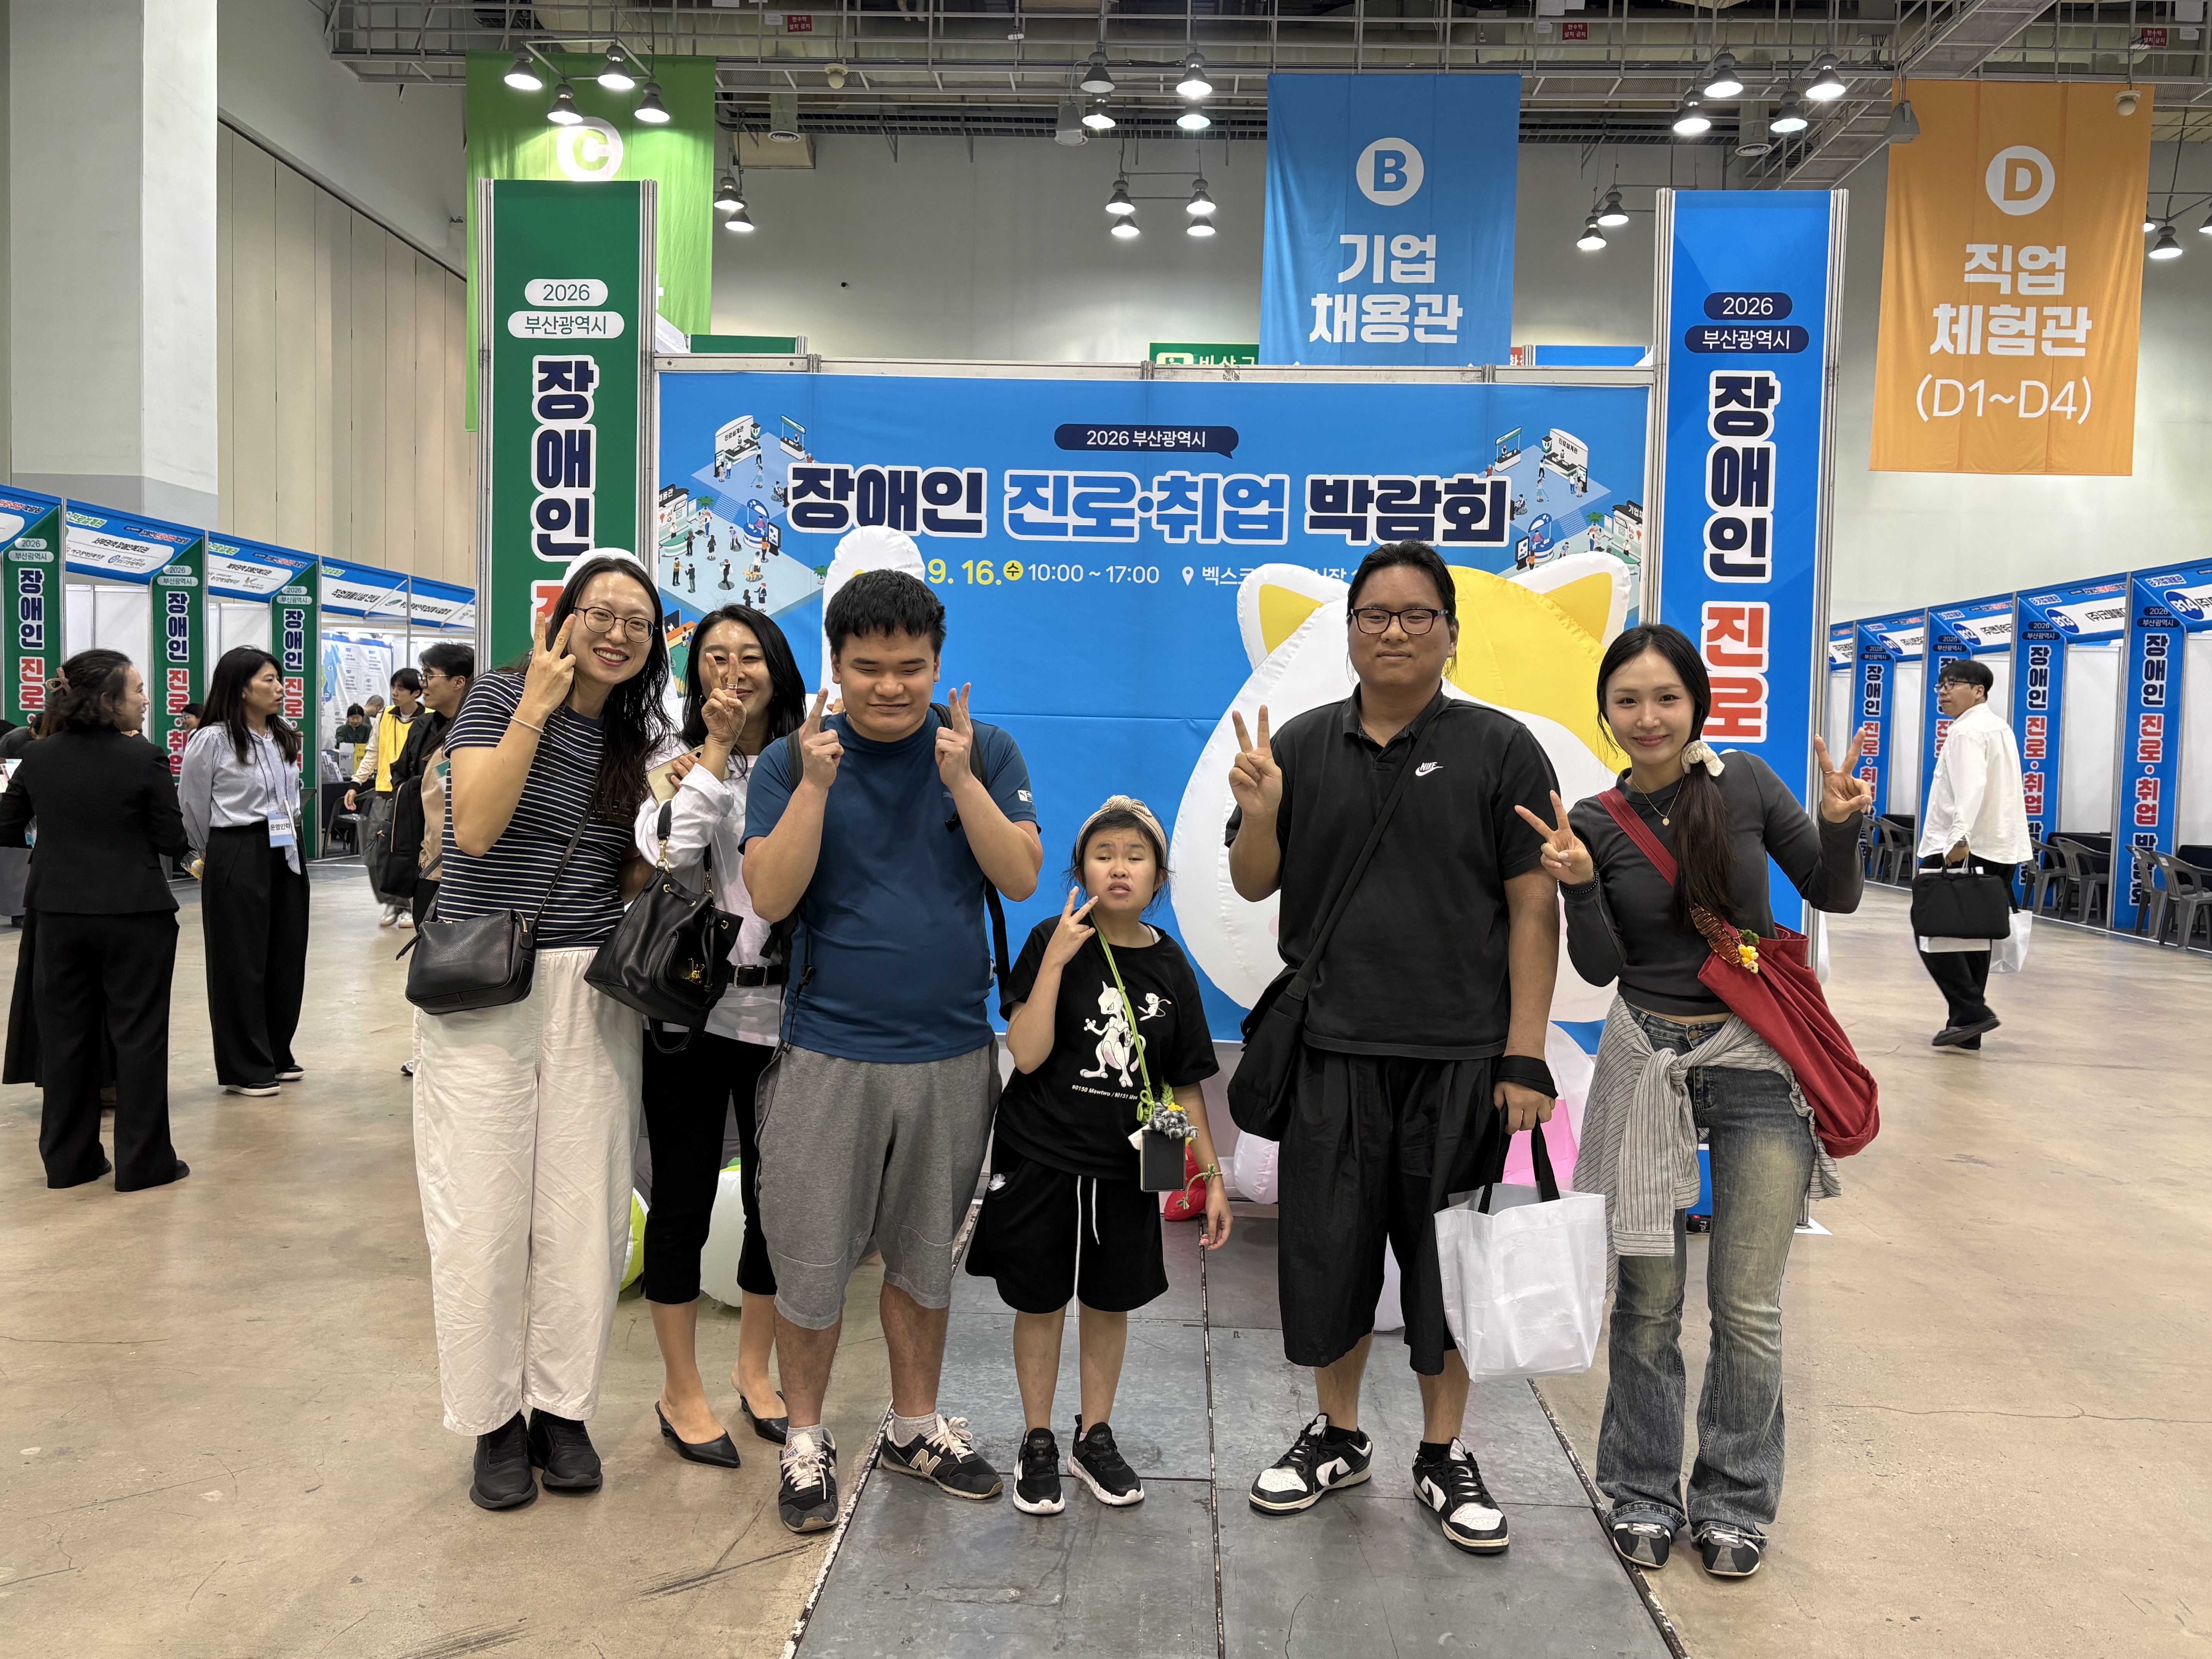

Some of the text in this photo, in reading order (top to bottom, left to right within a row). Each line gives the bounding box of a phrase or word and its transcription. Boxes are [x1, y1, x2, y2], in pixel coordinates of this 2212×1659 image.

[1373, 149, 1408, 191] B
[2003, 158, 2043, 201] D
[1338, 234, 1436, 283] 기업
[1964, 244, 2066, 295] 직업
[543, 284, 590, 301] 2026
[1722, 297, 1774, 315] 2026
[524, 315, 606, 335] 부산광역시
[1309, 293, 1463, 343] 채용관
[1702, 329, 1790, 350] 부산광역시
[1930, 303, 2092, 357] 체험관
[1916, 373, 2092, 425] (D1~D4)
[534, 359, 596, 558] 장애인
[1086, 430, 1206, 448] 2026 부산광역시
[1708, 375, 1776, 578] 장애인
[790, 466, 984, 534] 장애인
[1307, 476, 1508, 543] 박람회
[15, 552, 47, 561] 부산광역시
[1028, 563, 1084, 582] 10:00
[1106, 565, 1160, 584] 17:00
[19, 570, 43, 648] 장애인
[167, 592, 189, 661] 장애인
[2051, 615, 2075, 627] B13
[2170, 599, 2200, 613] B14
[285, 610, 305, 670] 장애인
[1864, 665, 1883, 716] 장애인
[2028, 646, 2050, 709] 장애인
[2143, 634, 2169, 706] 장애인
[1420, 762, 1438, 771] NIKE
[1089, 1087, 1111, 1096] Mewtwo
[909, 1448, 942, 1476] N
